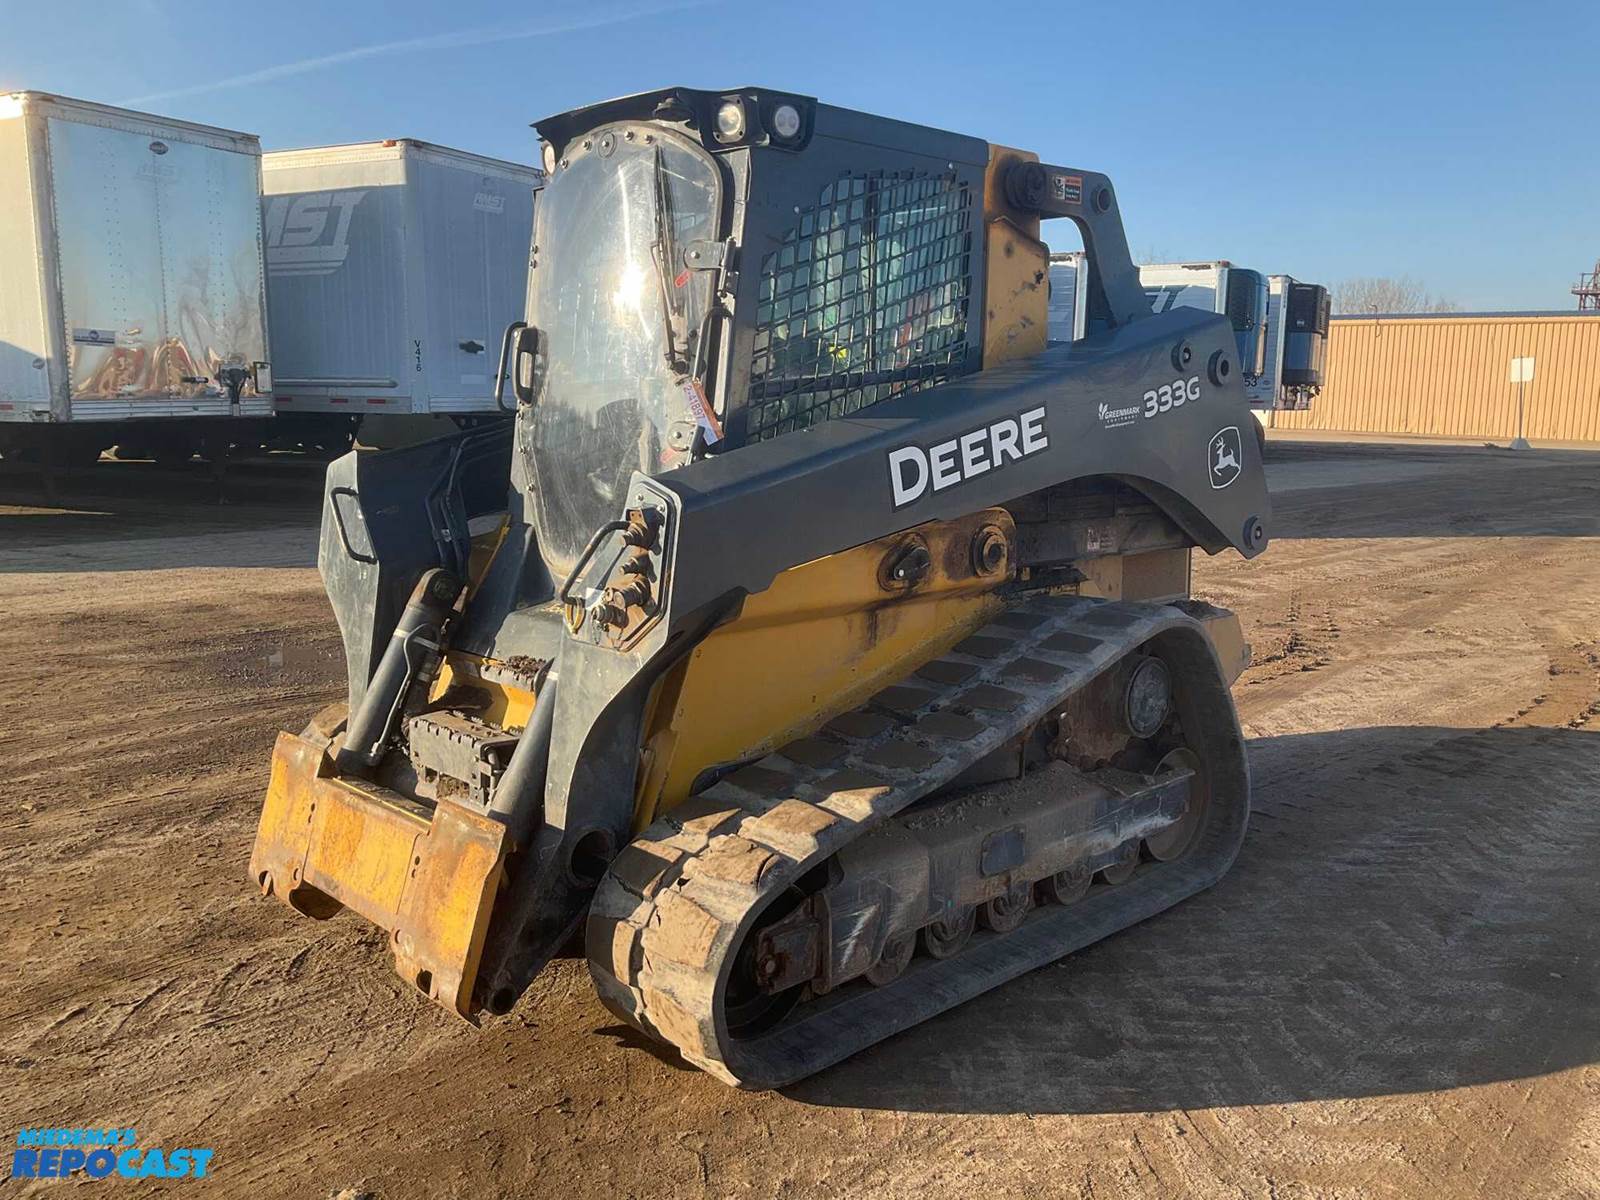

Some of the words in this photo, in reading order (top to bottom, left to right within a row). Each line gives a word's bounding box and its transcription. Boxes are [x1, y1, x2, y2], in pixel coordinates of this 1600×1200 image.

[414, 339, 422, 372] V416
[1104, 406, 1141, 420] GREENMARK
[1143, 376, 1200, 418] 333G
[888, 406, 1049, 507] DEERE
